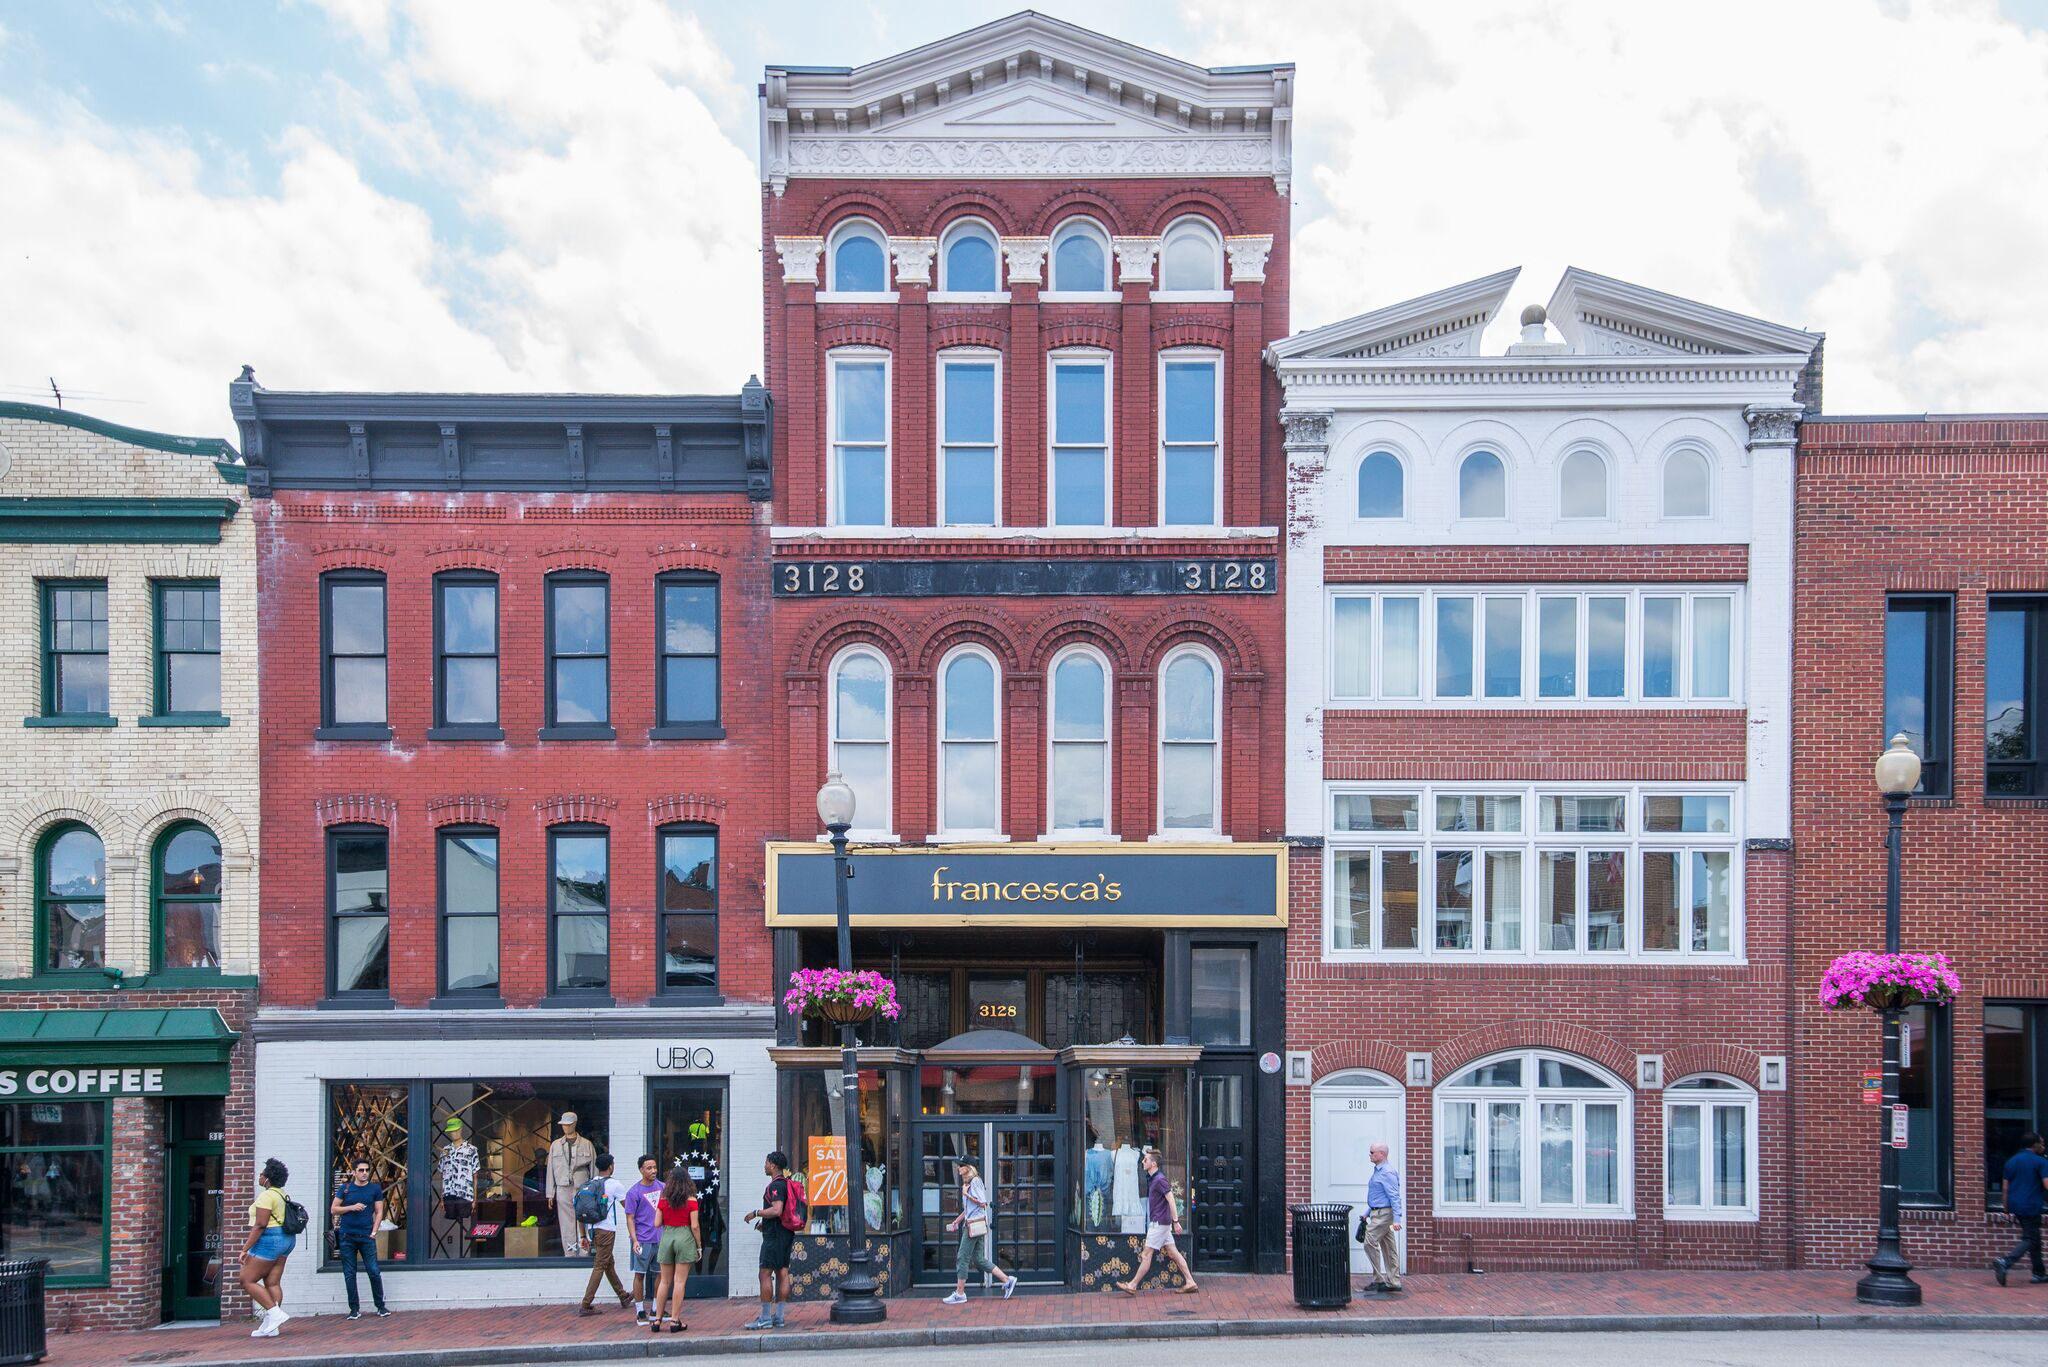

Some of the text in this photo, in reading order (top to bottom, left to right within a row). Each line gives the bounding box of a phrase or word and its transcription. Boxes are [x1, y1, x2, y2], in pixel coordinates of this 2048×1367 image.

[784, 565, 864, 592] 3128
[1185, 562, 1266, 590] 3128
[931, 866, 1122, 902] francesca's
[980, 1005, 1017, 1017] 3128
[656, 1047, 715, 1069] UBIQ
[26, 1068, 164, 1094] COFFEE
[1348, 1100, 1368, 1110] 3130
[208, 1132, 225, 1141] 312
[816, 1149, 844, 1161] SAL
[205, 1234, 224, 1242] COL
